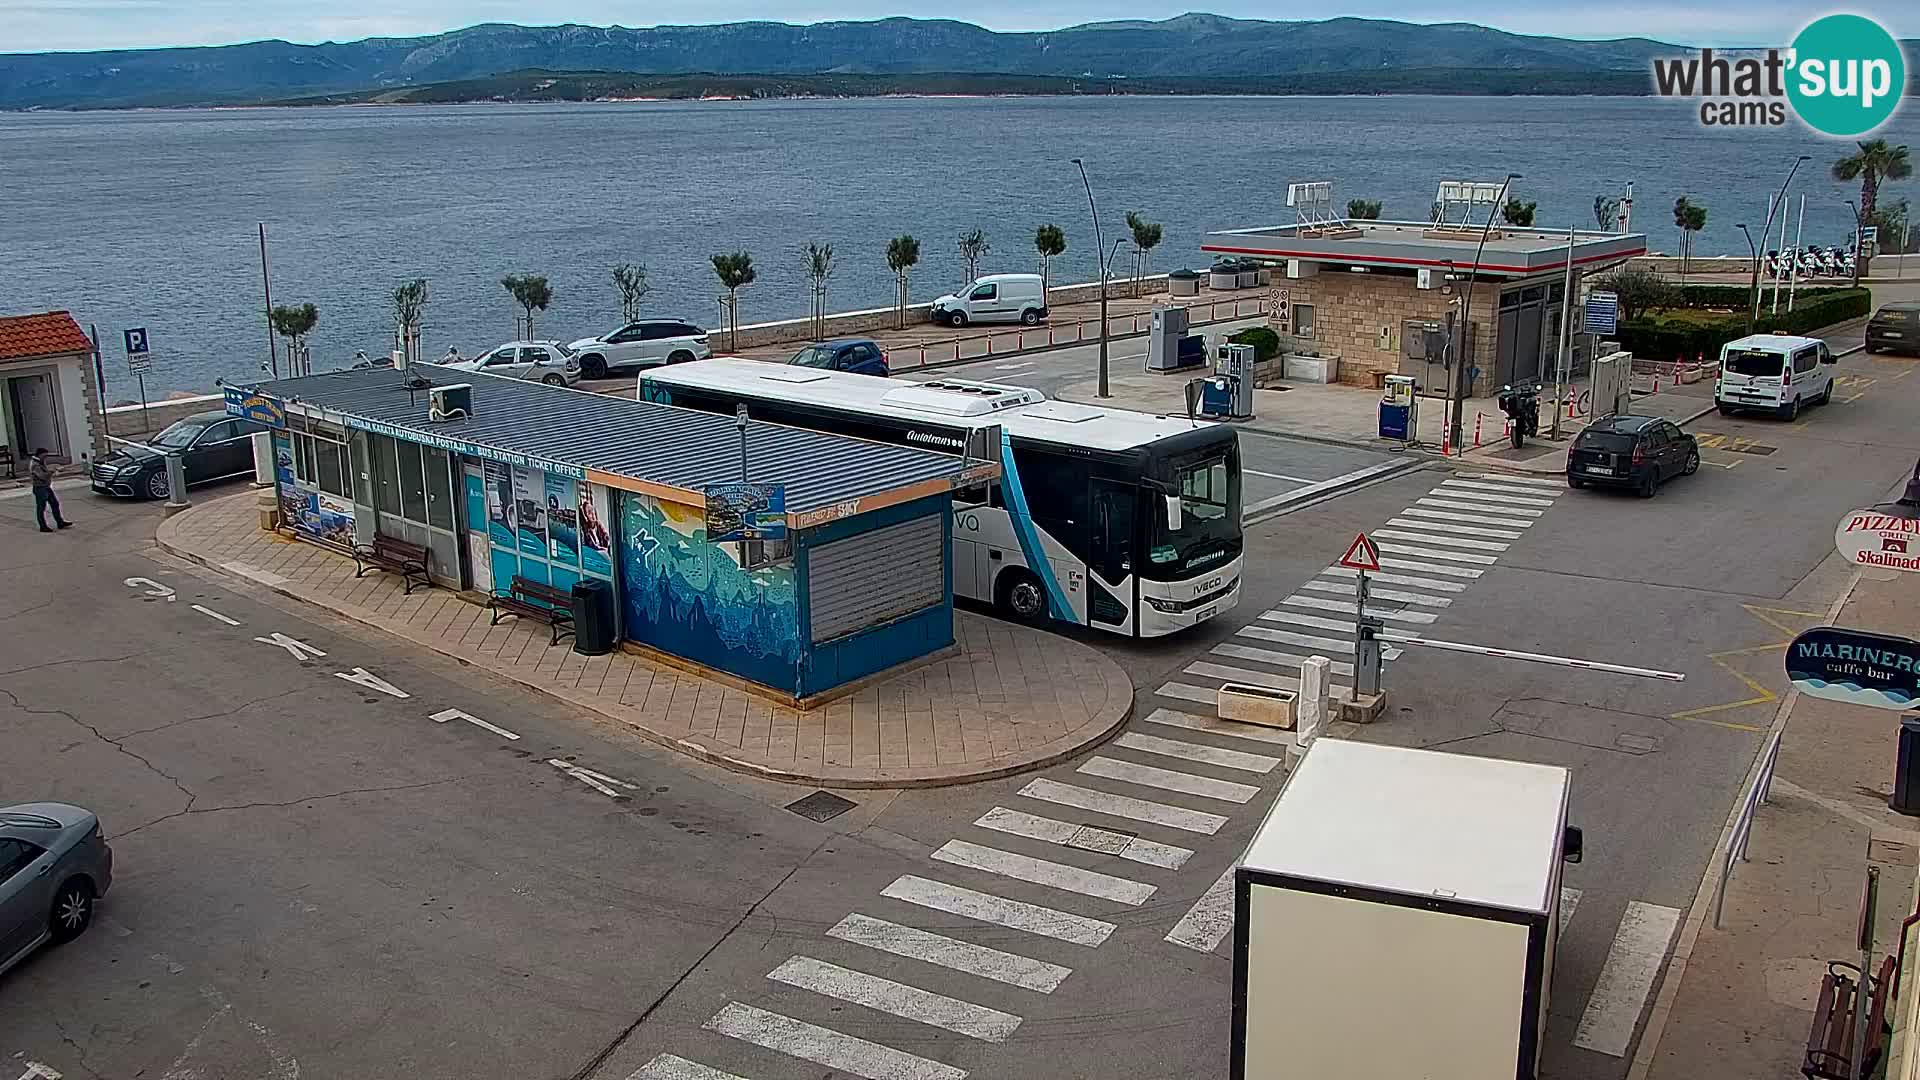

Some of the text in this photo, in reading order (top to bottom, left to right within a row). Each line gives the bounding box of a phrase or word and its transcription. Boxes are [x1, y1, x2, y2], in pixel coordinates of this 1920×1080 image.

[130, 332, 142, 350] P
[395, 427, 435, 446] AUTOBUSNA
[436, 436, 467, 453] POSTAJA
[477, 447, 492, 459] BUS
[493, 450, 525, 466] STATION
[528, 457, 554, 472] TICKET
[554, 463, 581, 478] OFFICE
[1879, 531, 1913, 541] GRILL
[1193, 576, 1221, 596] IVECO
[1826, 661, 1895, 681] caffe bar
